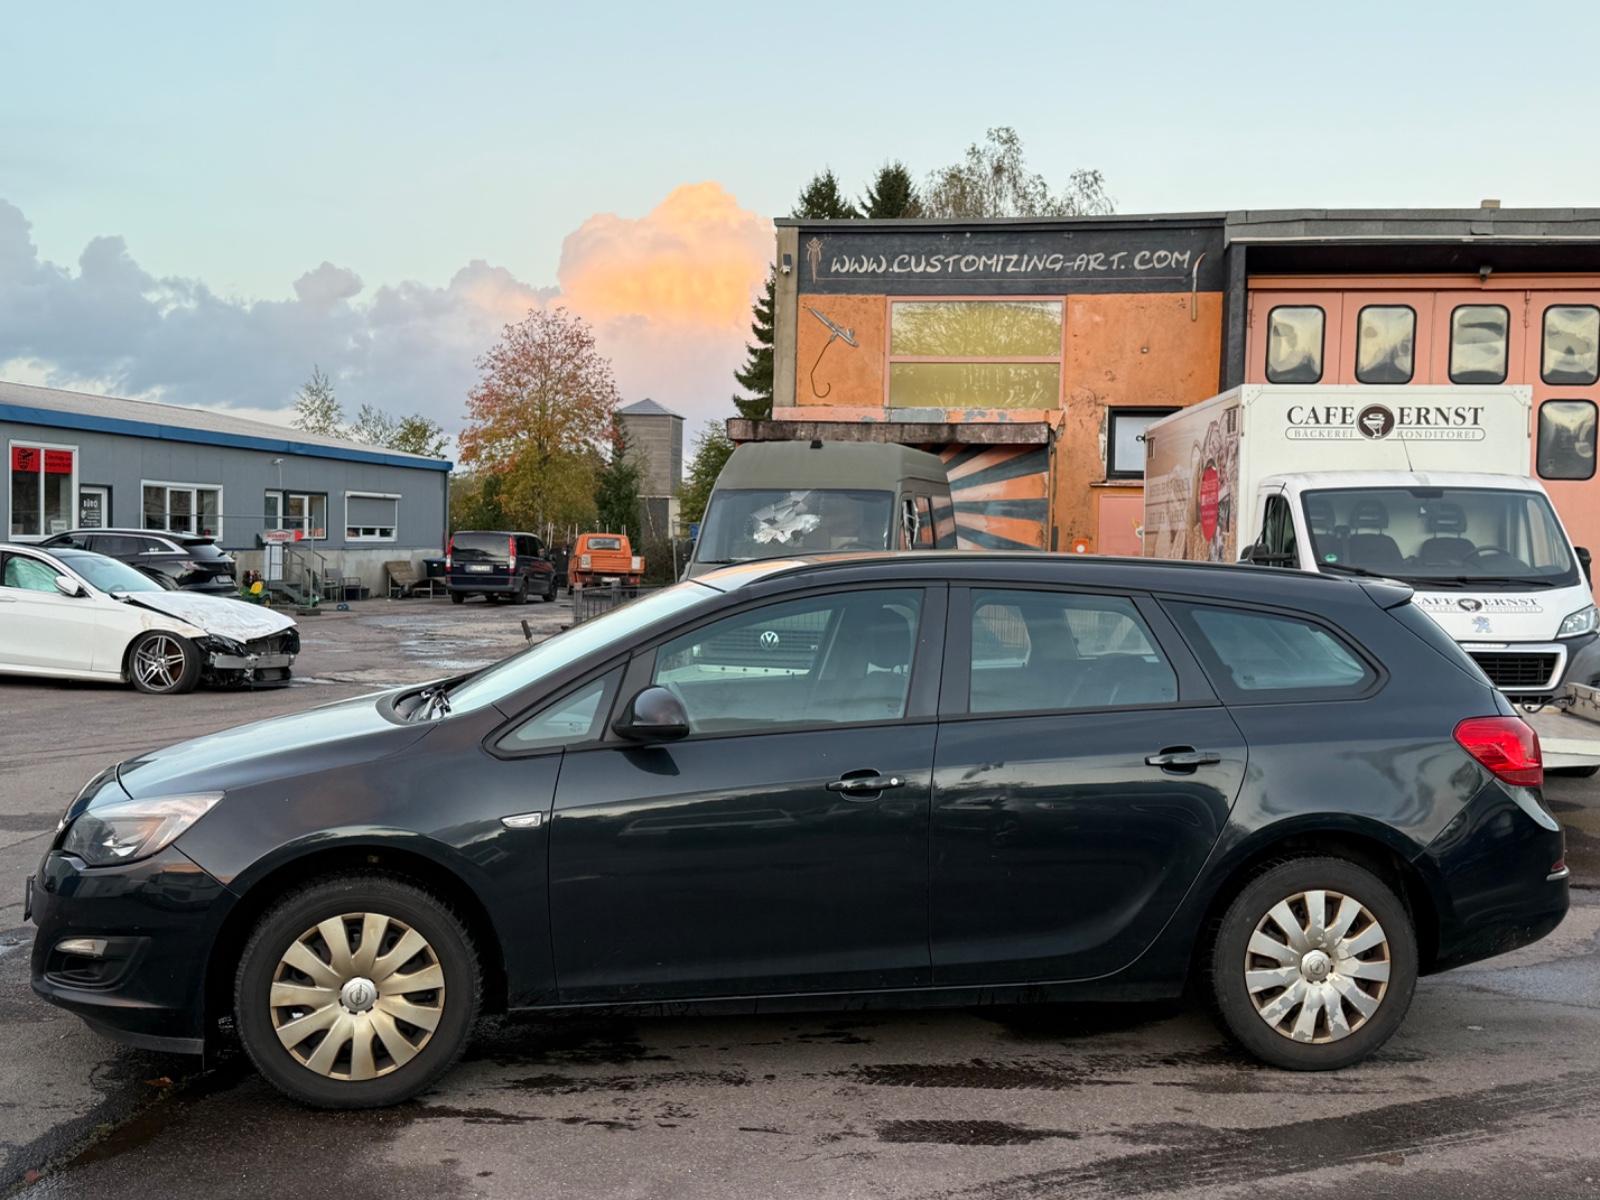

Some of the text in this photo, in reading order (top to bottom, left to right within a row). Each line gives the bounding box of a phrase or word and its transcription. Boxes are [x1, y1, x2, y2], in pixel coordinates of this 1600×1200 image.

[1286, 405, 1485, 426] CAFE ERNST
[1396, 430, 1476, 439] KONDITOREI
